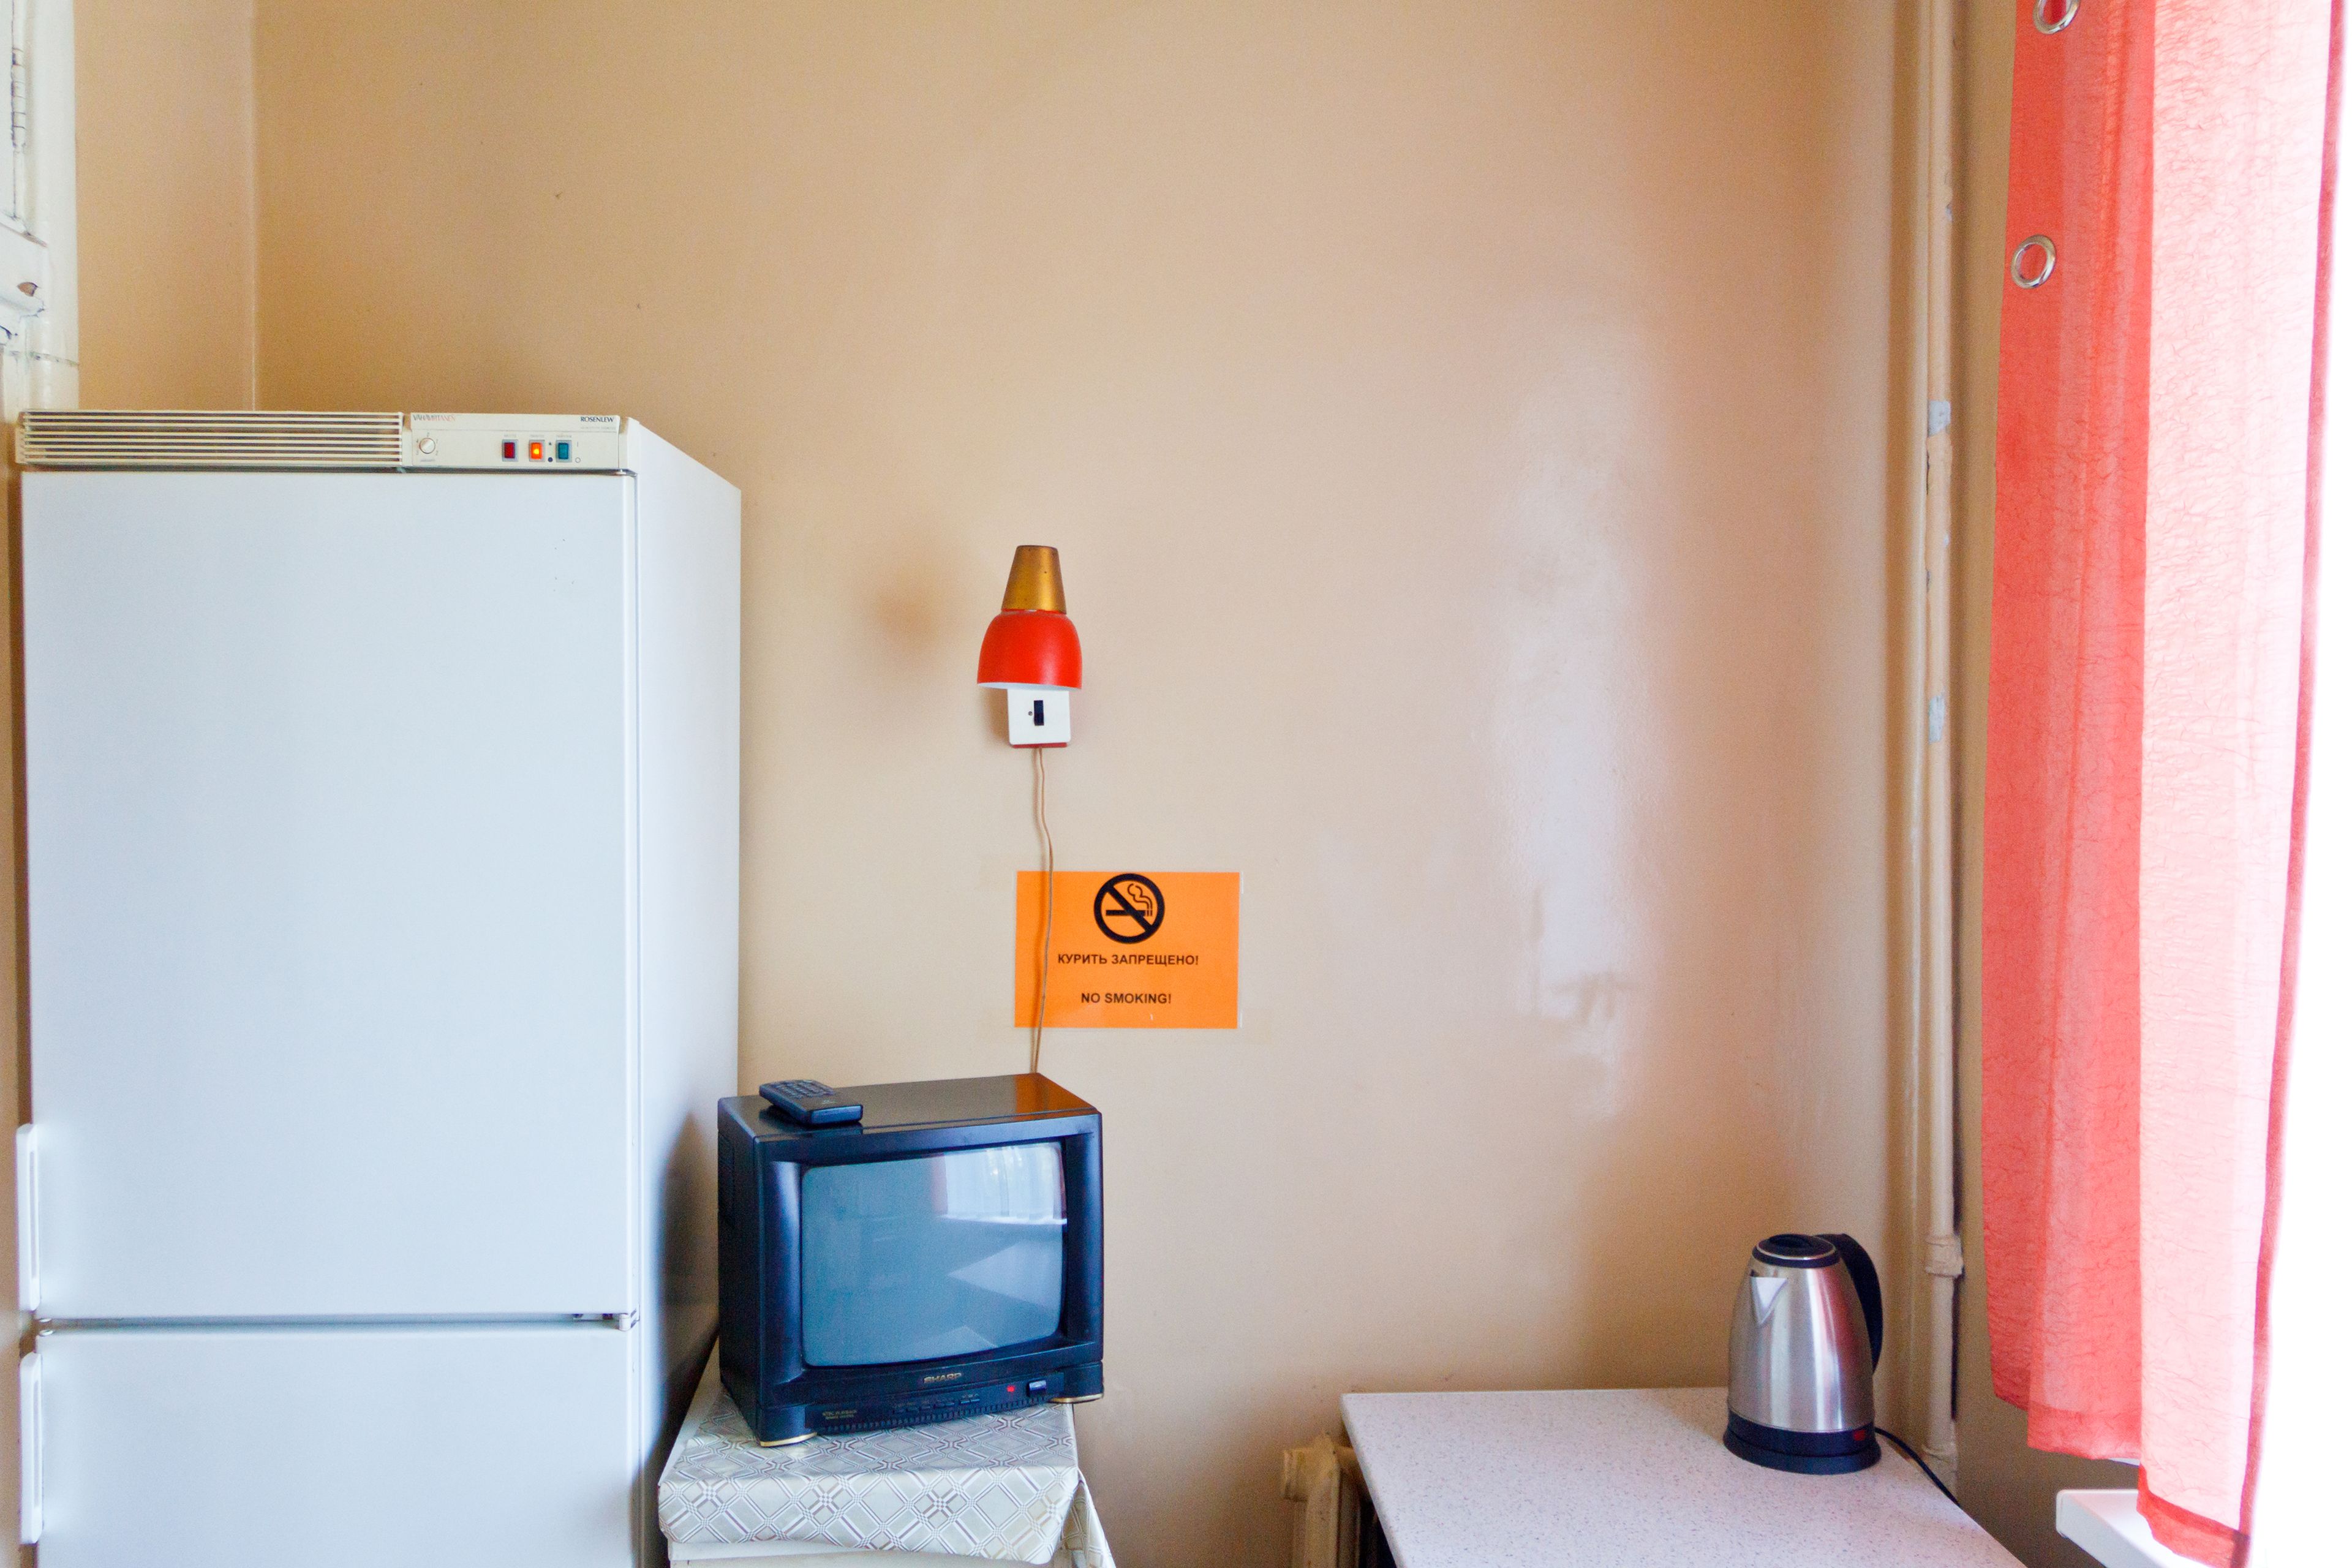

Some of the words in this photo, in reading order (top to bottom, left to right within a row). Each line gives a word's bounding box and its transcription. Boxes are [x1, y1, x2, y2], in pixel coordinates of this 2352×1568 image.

[1057, 954, 1107, 965] КУРИТЬ
[1111, 954, 1199, 967] ЗАПРЕЩЕНО!
[1080, 993, 1100, 1004] NO
[1105, 993, 1172, 1004] SMOKING!
[923, 1372, 962, 1384] SHARP
